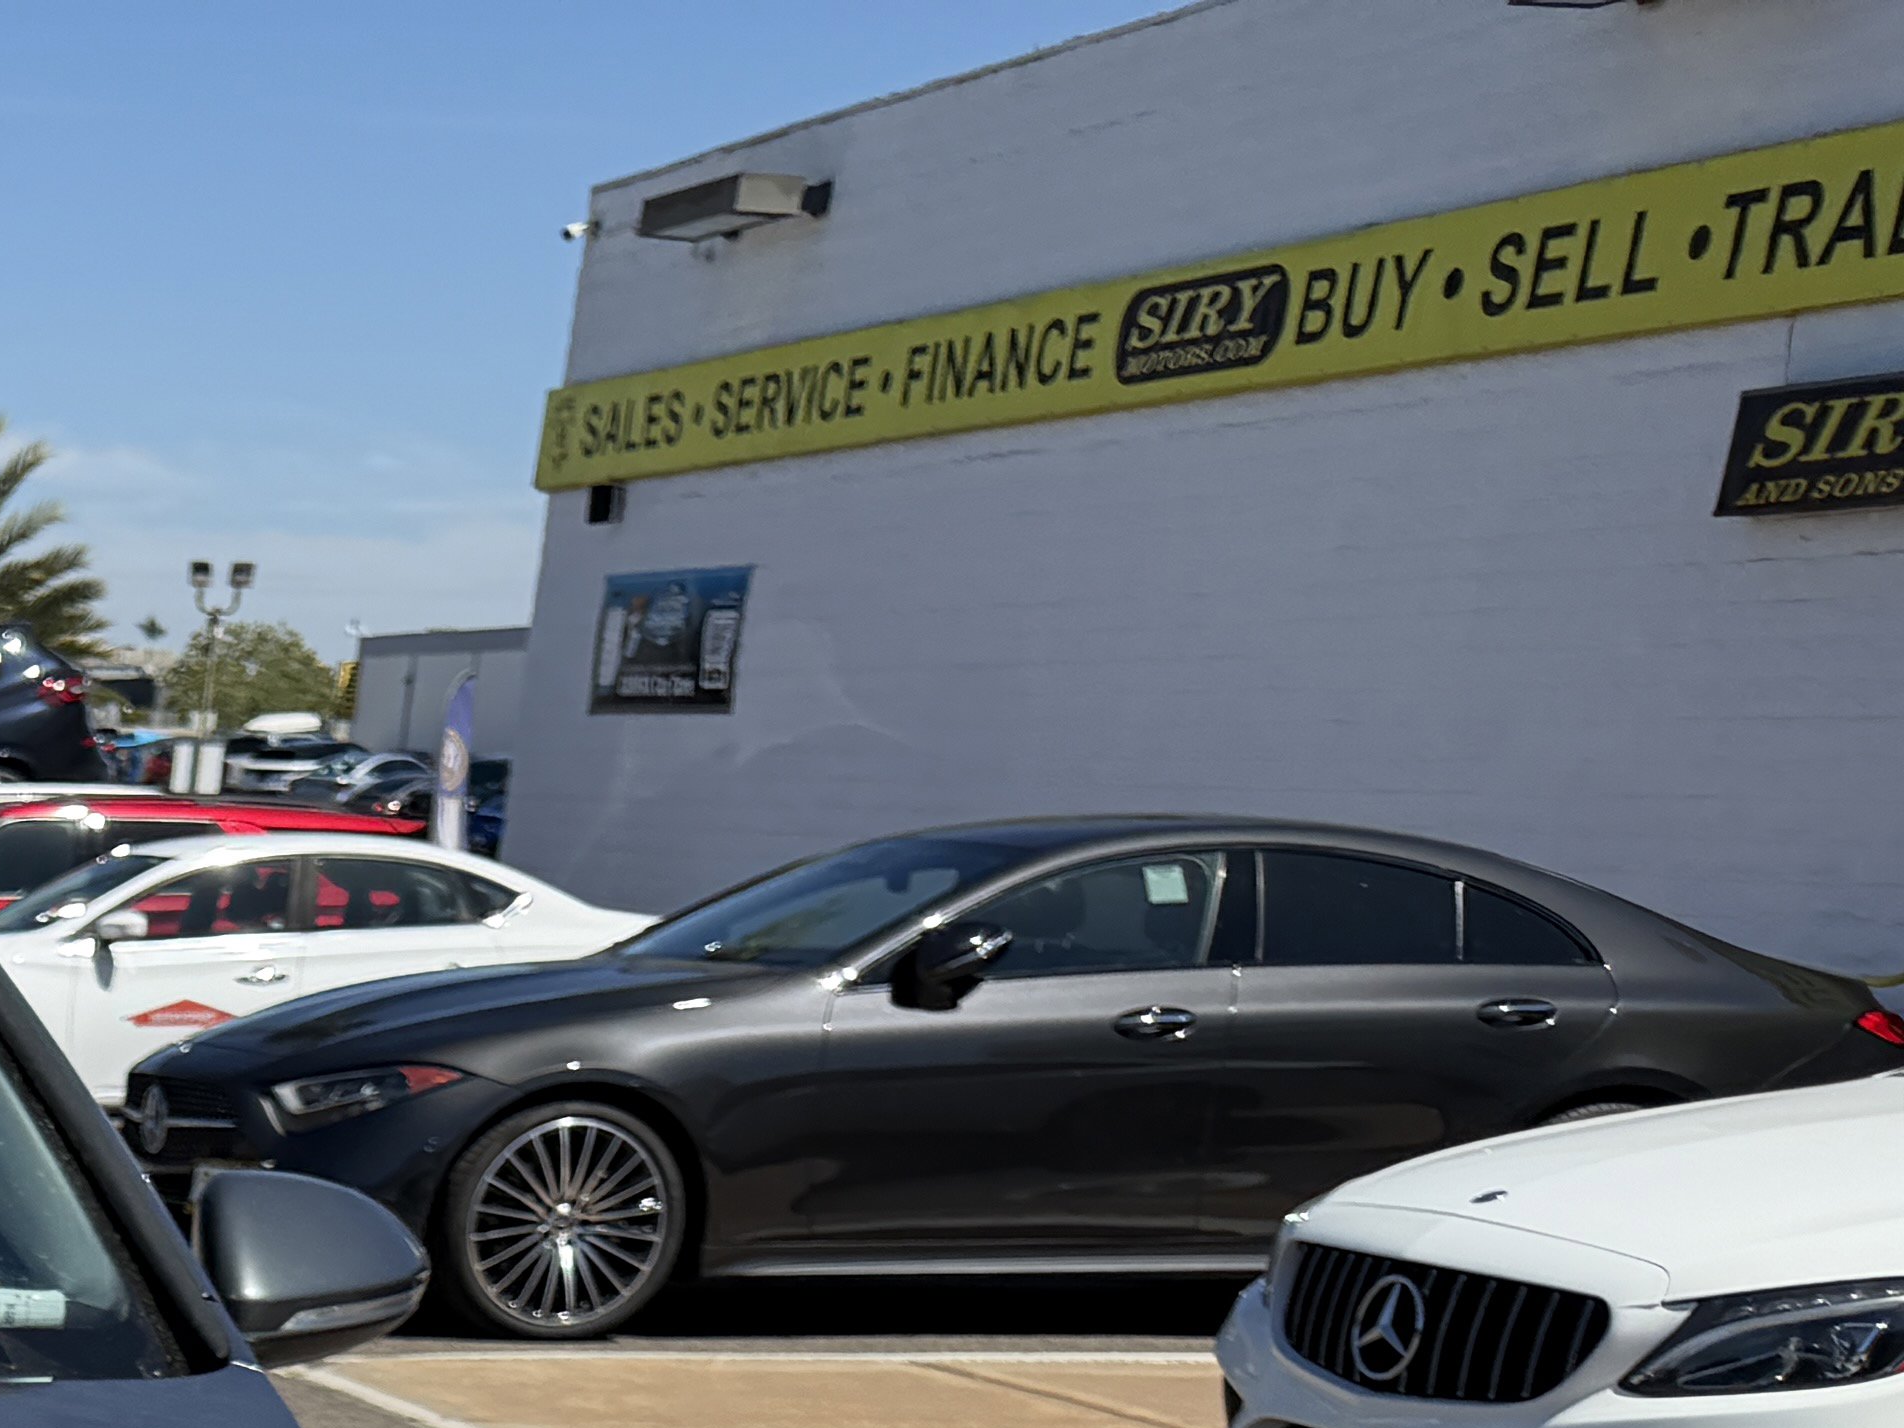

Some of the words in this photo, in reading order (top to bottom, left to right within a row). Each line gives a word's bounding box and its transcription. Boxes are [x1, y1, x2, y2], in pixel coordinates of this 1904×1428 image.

[1124, 273, 1282, 351] SIRY
[1295, 248, 1434, 345] BUY
[1481, 210, 1659, 318] SELL
[580, 389, 687, 459] SALES
[709, 355, 871, 440] SERVICE
[899, 313, 1101, 408] FINANCE
[1744, 391, 1904, 469] SIR
[1734, 478, 1809, 507] AND
[1809, 468, 1904, 500] SONS
